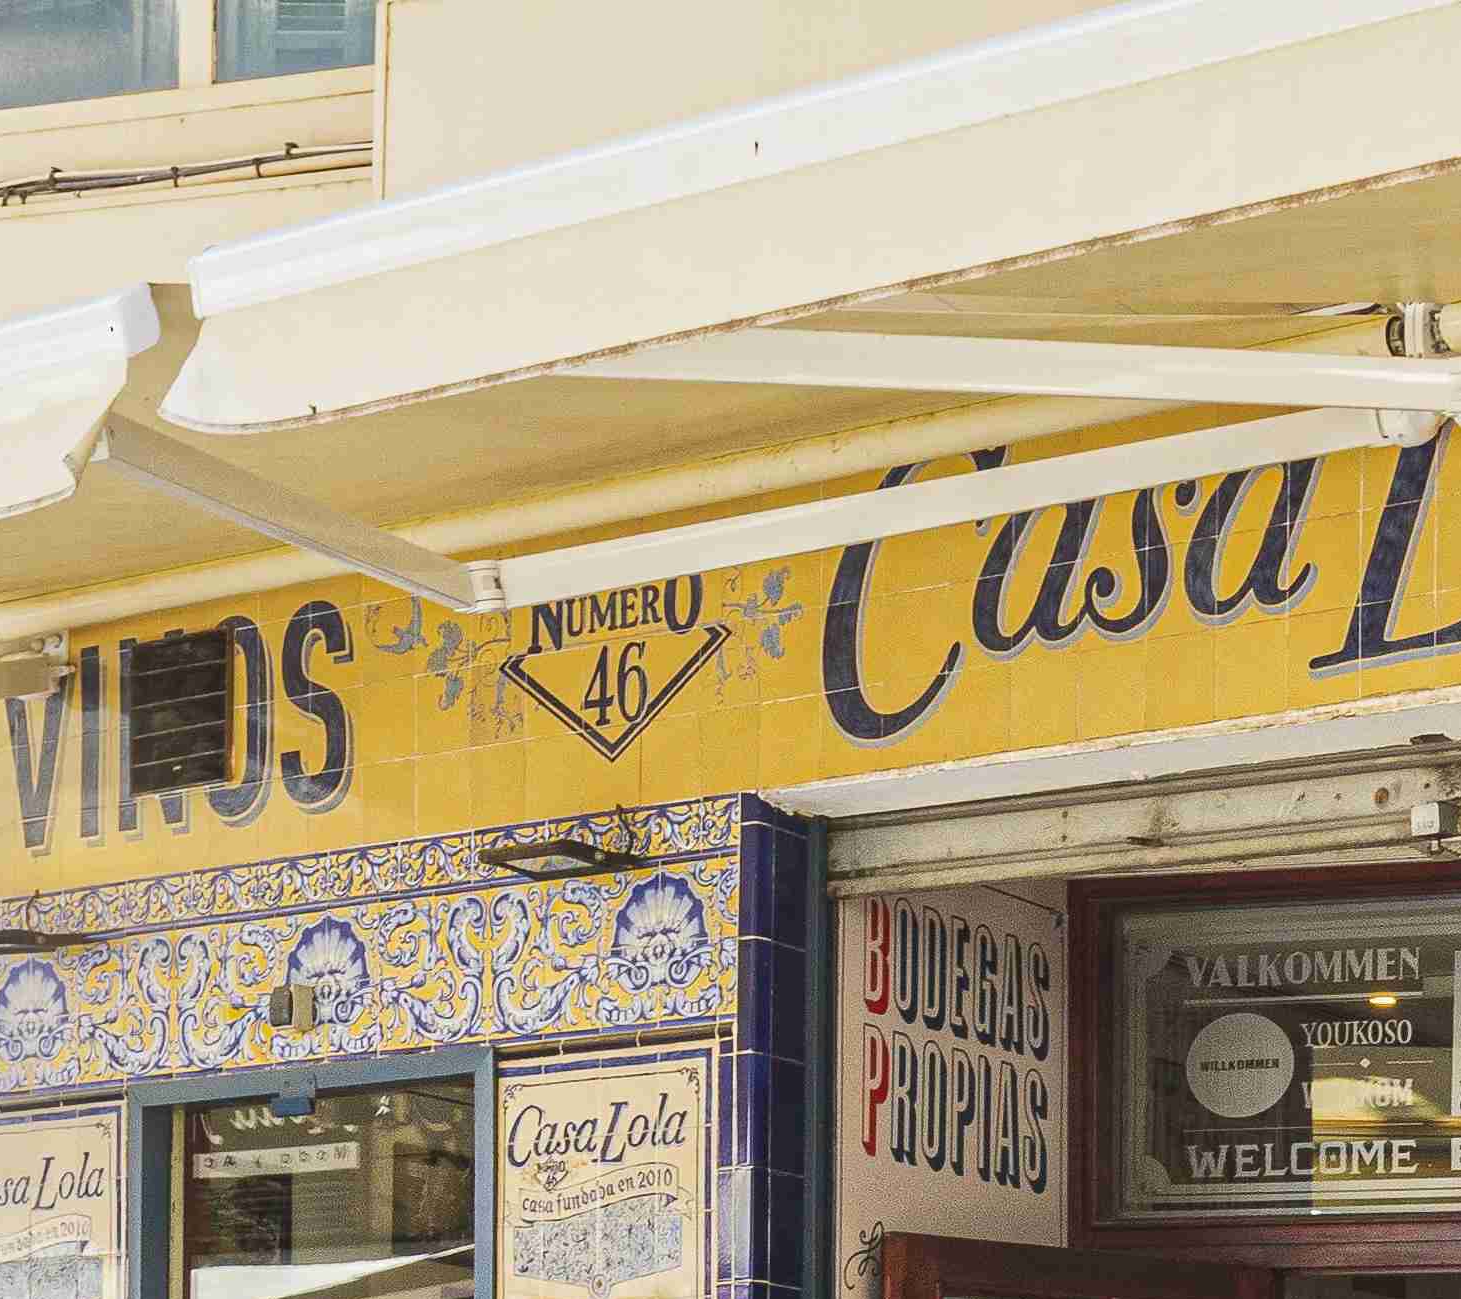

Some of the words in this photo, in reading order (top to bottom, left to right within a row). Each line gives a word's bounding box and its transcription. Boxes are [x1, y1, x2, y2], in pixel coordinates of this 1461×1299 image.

[821, 447, 1319, 747] Casa
[581, 642, 649, 727] 46
[863, 893, 1050, 1061] BODEGAS
[1199, 1057, 1280, 1072] WILLKOMMEN
[1300, 1018, 1413, 1049] YOUKOSO
[506, 1104, 598, 1168] Casa
[592, 1092, 687, 1164] Lola
[861, 1021, 1048, 1194] PROPIAS
[31, 1151, 105, 1211] Lola
[522, 1197, 554, 1215] casa
[618, 1175, 635, 1193] en
[637, 1168, 673, 1189] 2010
[1185, 1138, 1419, 1180] WELCOME
